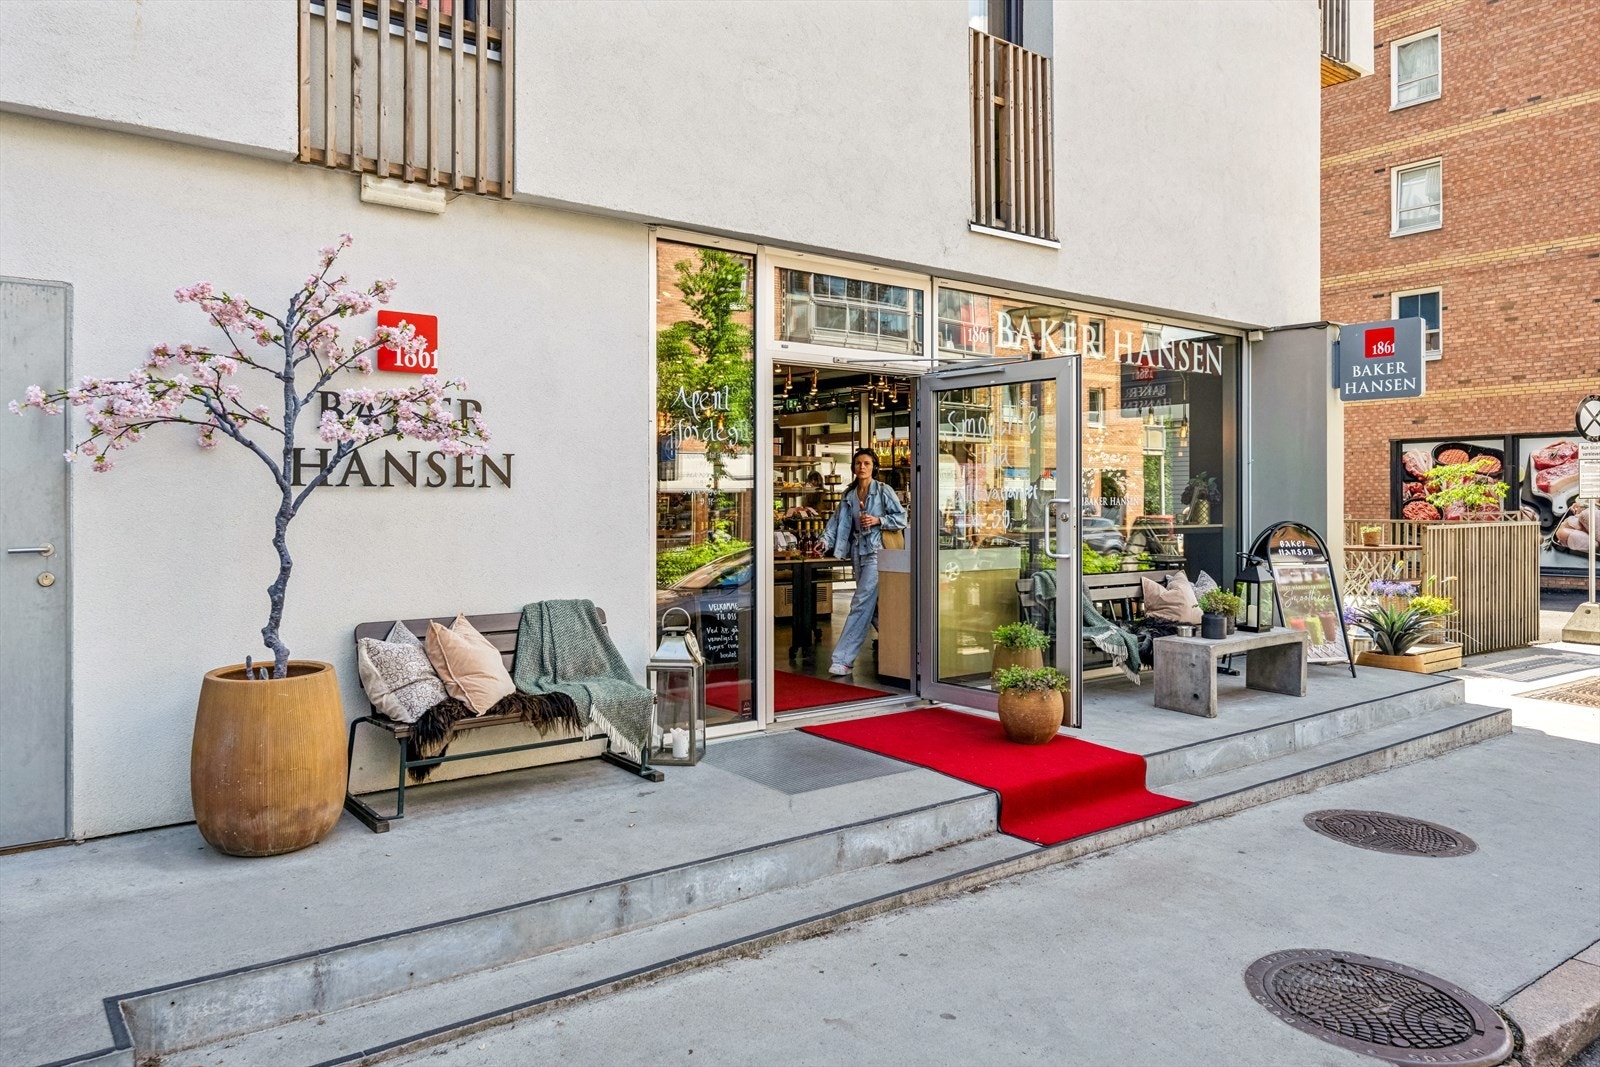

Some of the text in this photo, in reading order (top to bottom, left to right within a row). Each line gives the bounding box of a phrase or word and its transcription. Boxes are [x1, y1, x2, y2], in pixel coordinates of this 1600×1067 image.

[968, 324, 990, 344] 1861
[996, 311, 1224, 376] BAKER HANSEN
[1372, 341, 1396, 355] 1861
[1352, 361, 1408, 378] BAKER
[1345, 377, 1417, 394] HANSEN
[291, 447, 515, 489] HANSEN
